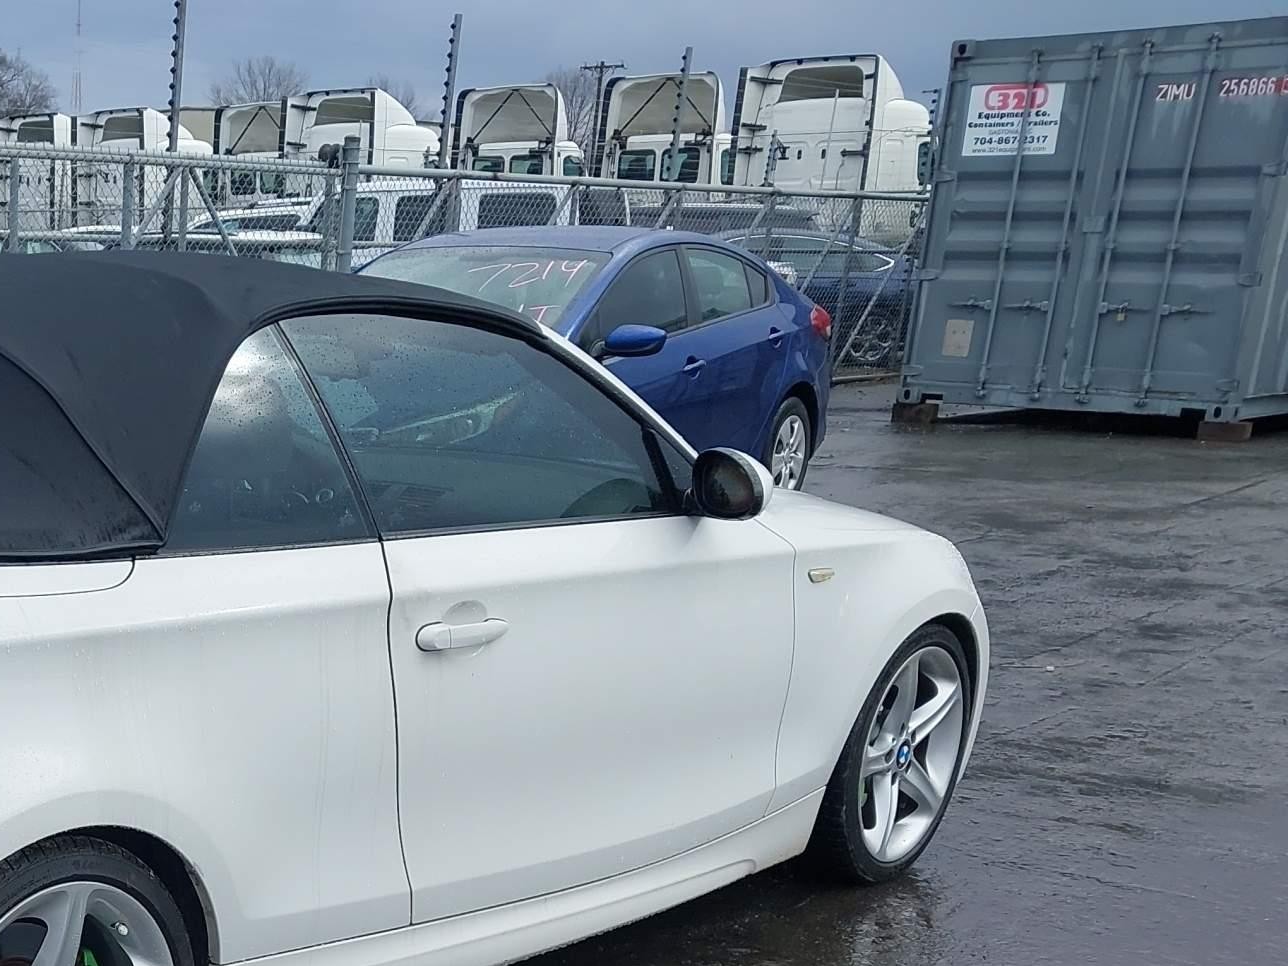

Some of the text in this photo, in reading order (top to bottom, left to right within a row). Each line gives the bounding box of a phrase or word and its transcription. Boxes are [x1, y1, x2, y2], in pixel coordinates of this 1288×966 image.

[998, 91, 1038, 110] 321
[1156, 83, 1197, 101] ZIMU
[1034, 109, 1051, 117] Co.
[967, 120, 1015, 128] Containers
[467, 259, 589, 293] 7214
